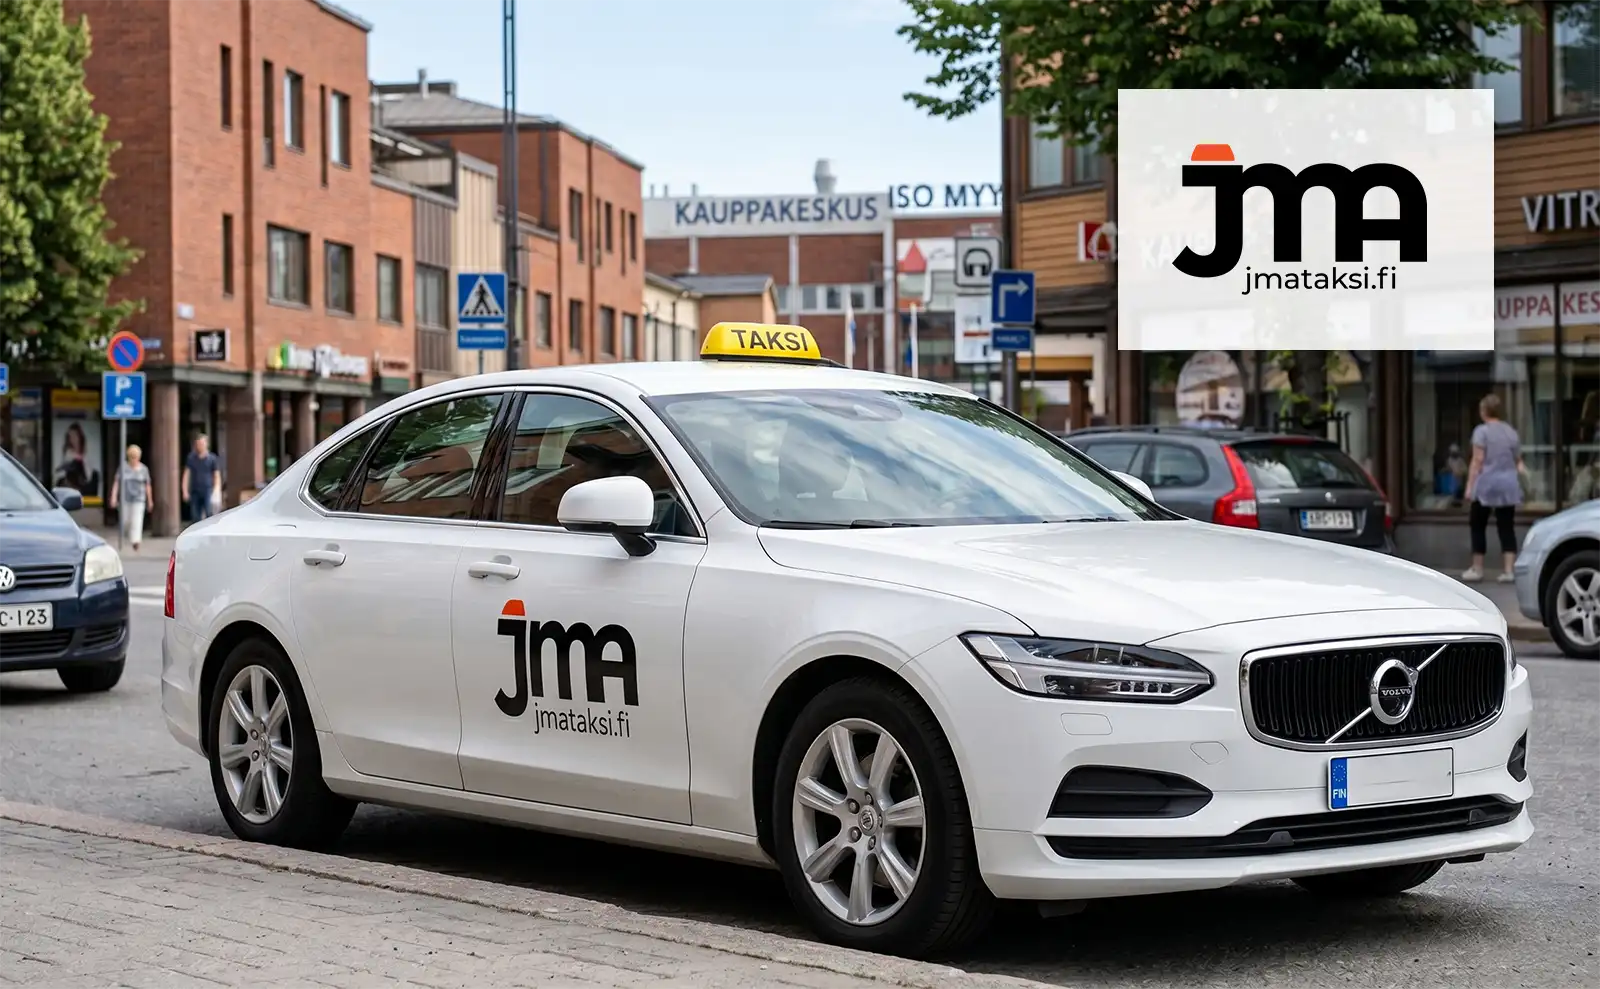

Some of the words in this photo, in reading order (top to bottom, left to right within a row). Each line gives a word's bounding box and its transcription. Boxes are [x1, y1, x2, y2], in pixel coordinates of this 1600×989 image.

[675, 197, 878, 226] KAUPPAKESKUS
[888, 184, 933, 209] ISO
[1520, 189, 1600, 233] VITR
[1494, 294, 1553, 320] UPPA
[731, 329, 808, 352] TAKSI
[1381, 688, 1412, 696] VOLVO
[534, 702, 630, 738] jmataksi.fi
[1333, 788, 1347, 800] FIN
